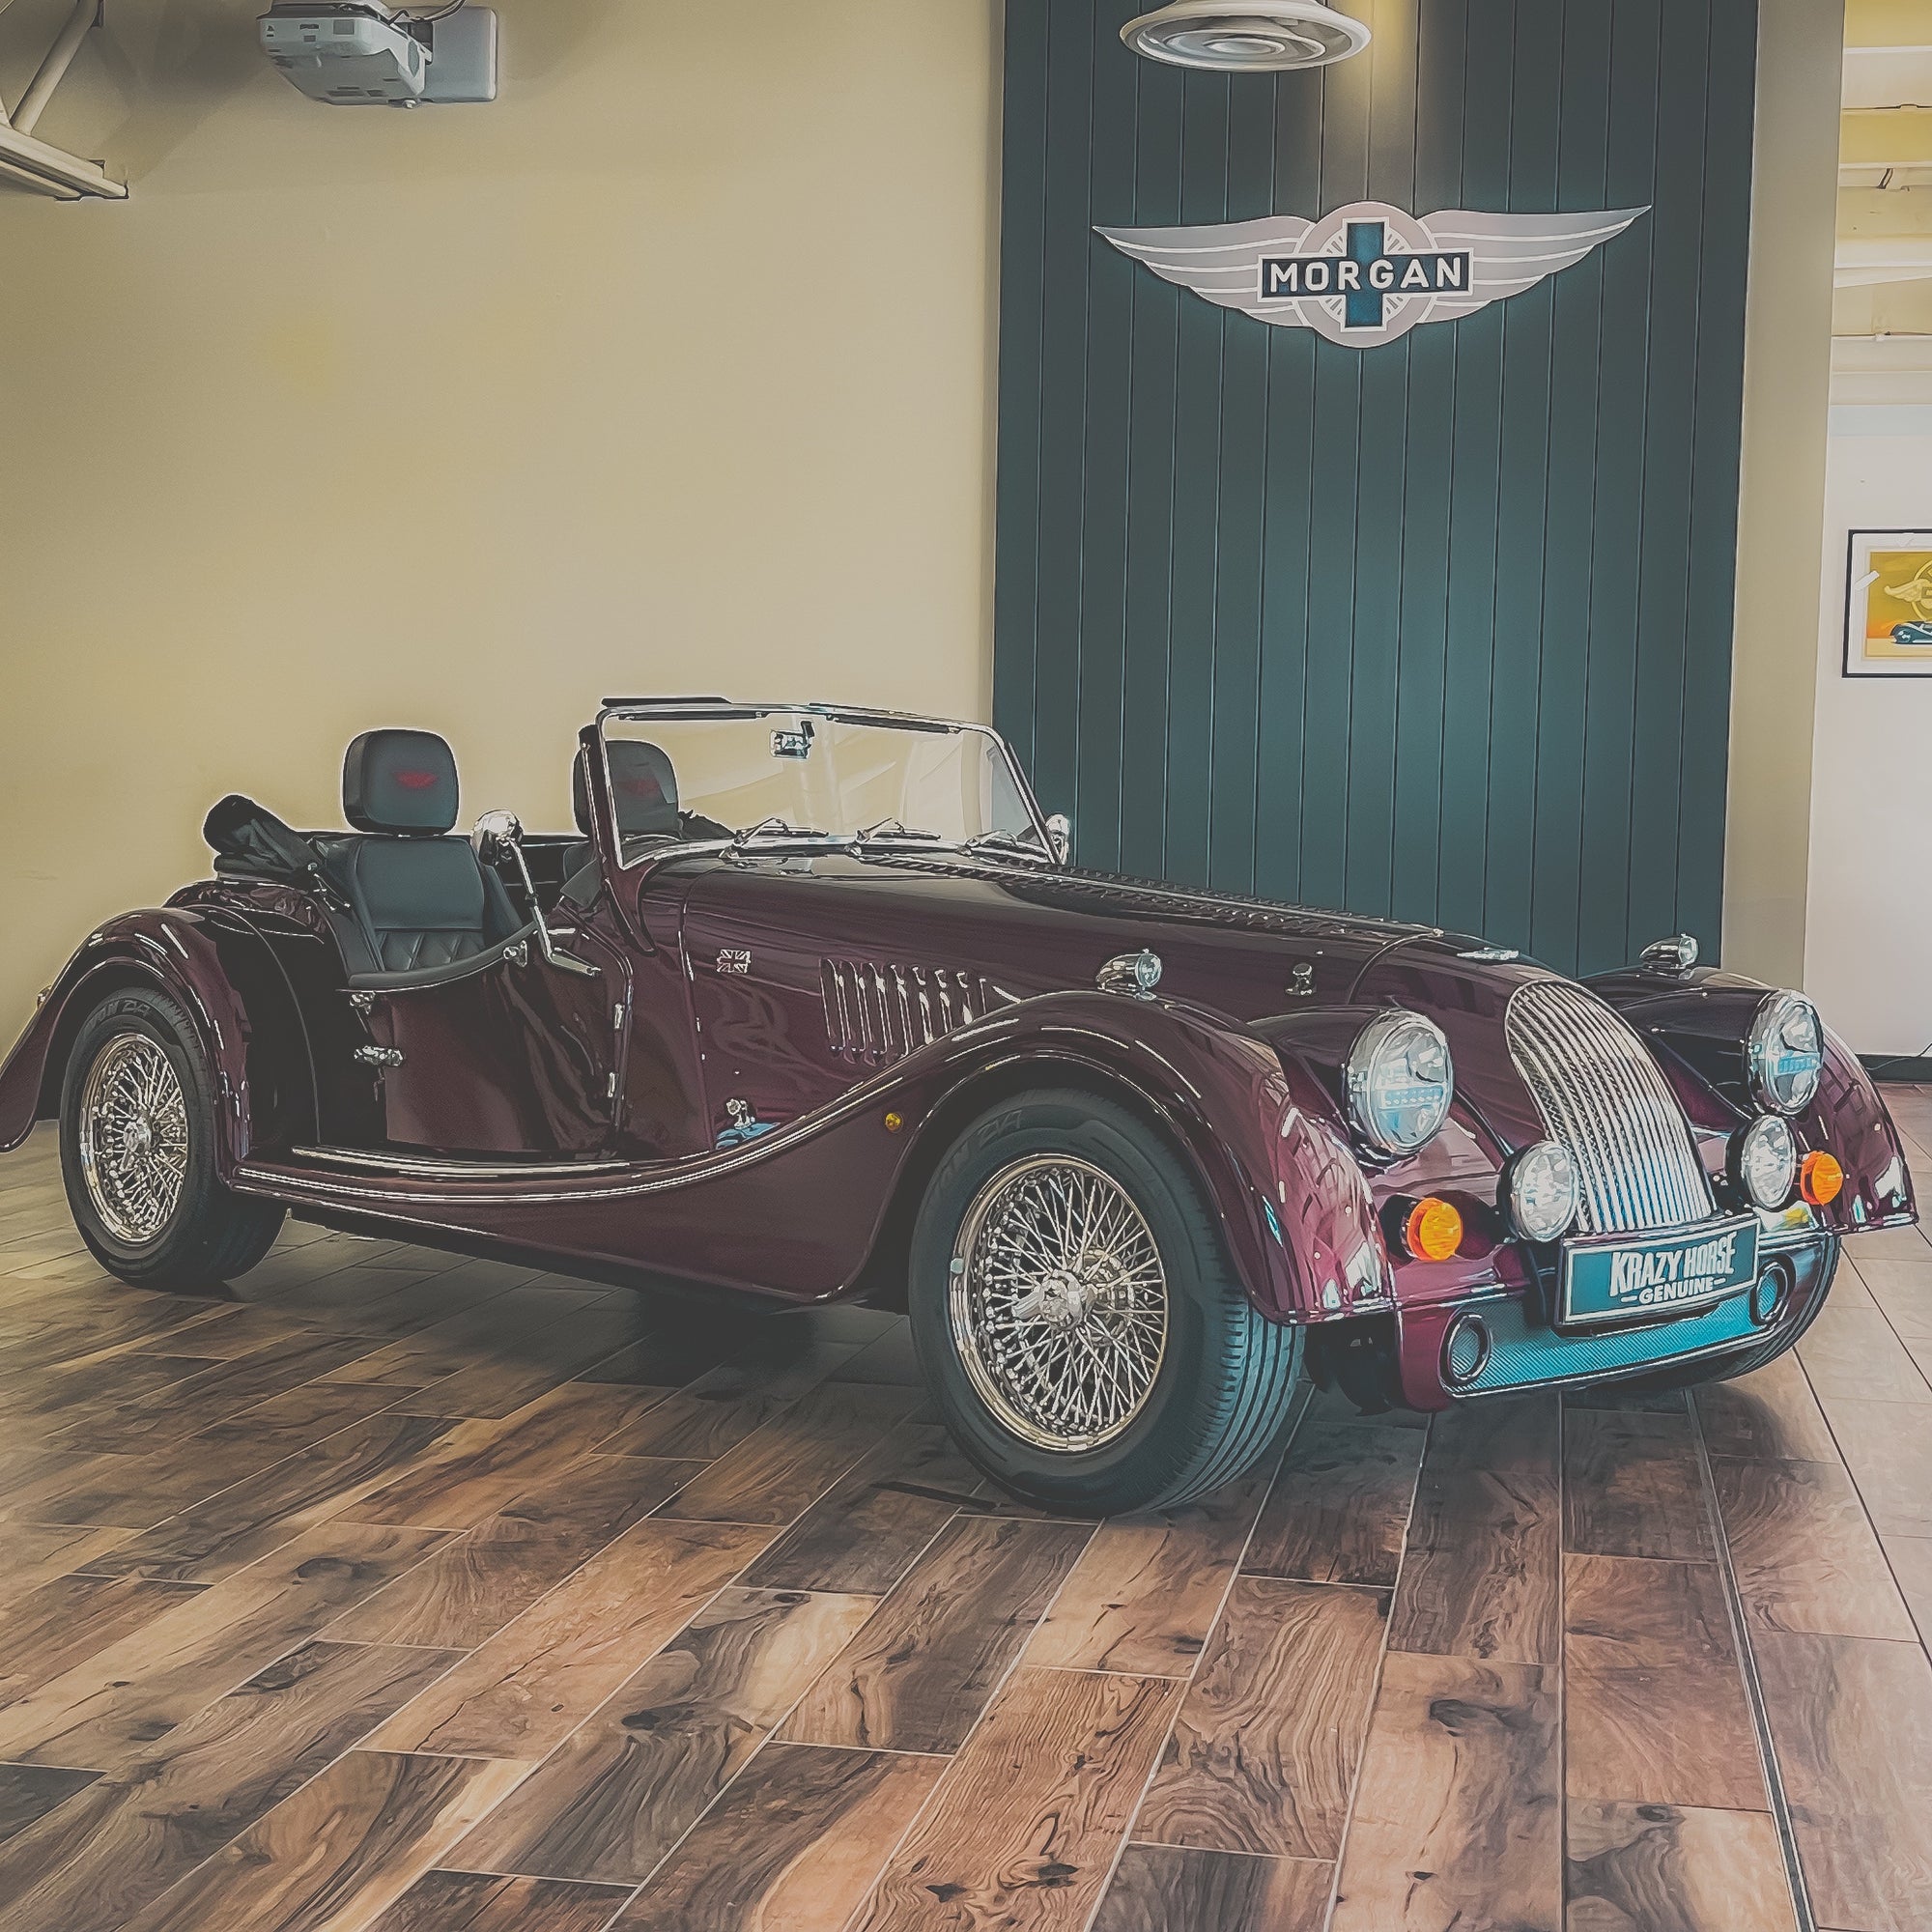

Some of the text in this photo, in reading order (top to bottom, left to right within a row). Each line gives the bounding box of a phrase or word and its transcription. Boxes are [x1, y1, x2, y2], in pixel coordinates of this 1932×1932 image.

[1270, 257, 1462, 293] MORGAN
[1609, 1232, 1738, 1296] KRAZY HORSE
